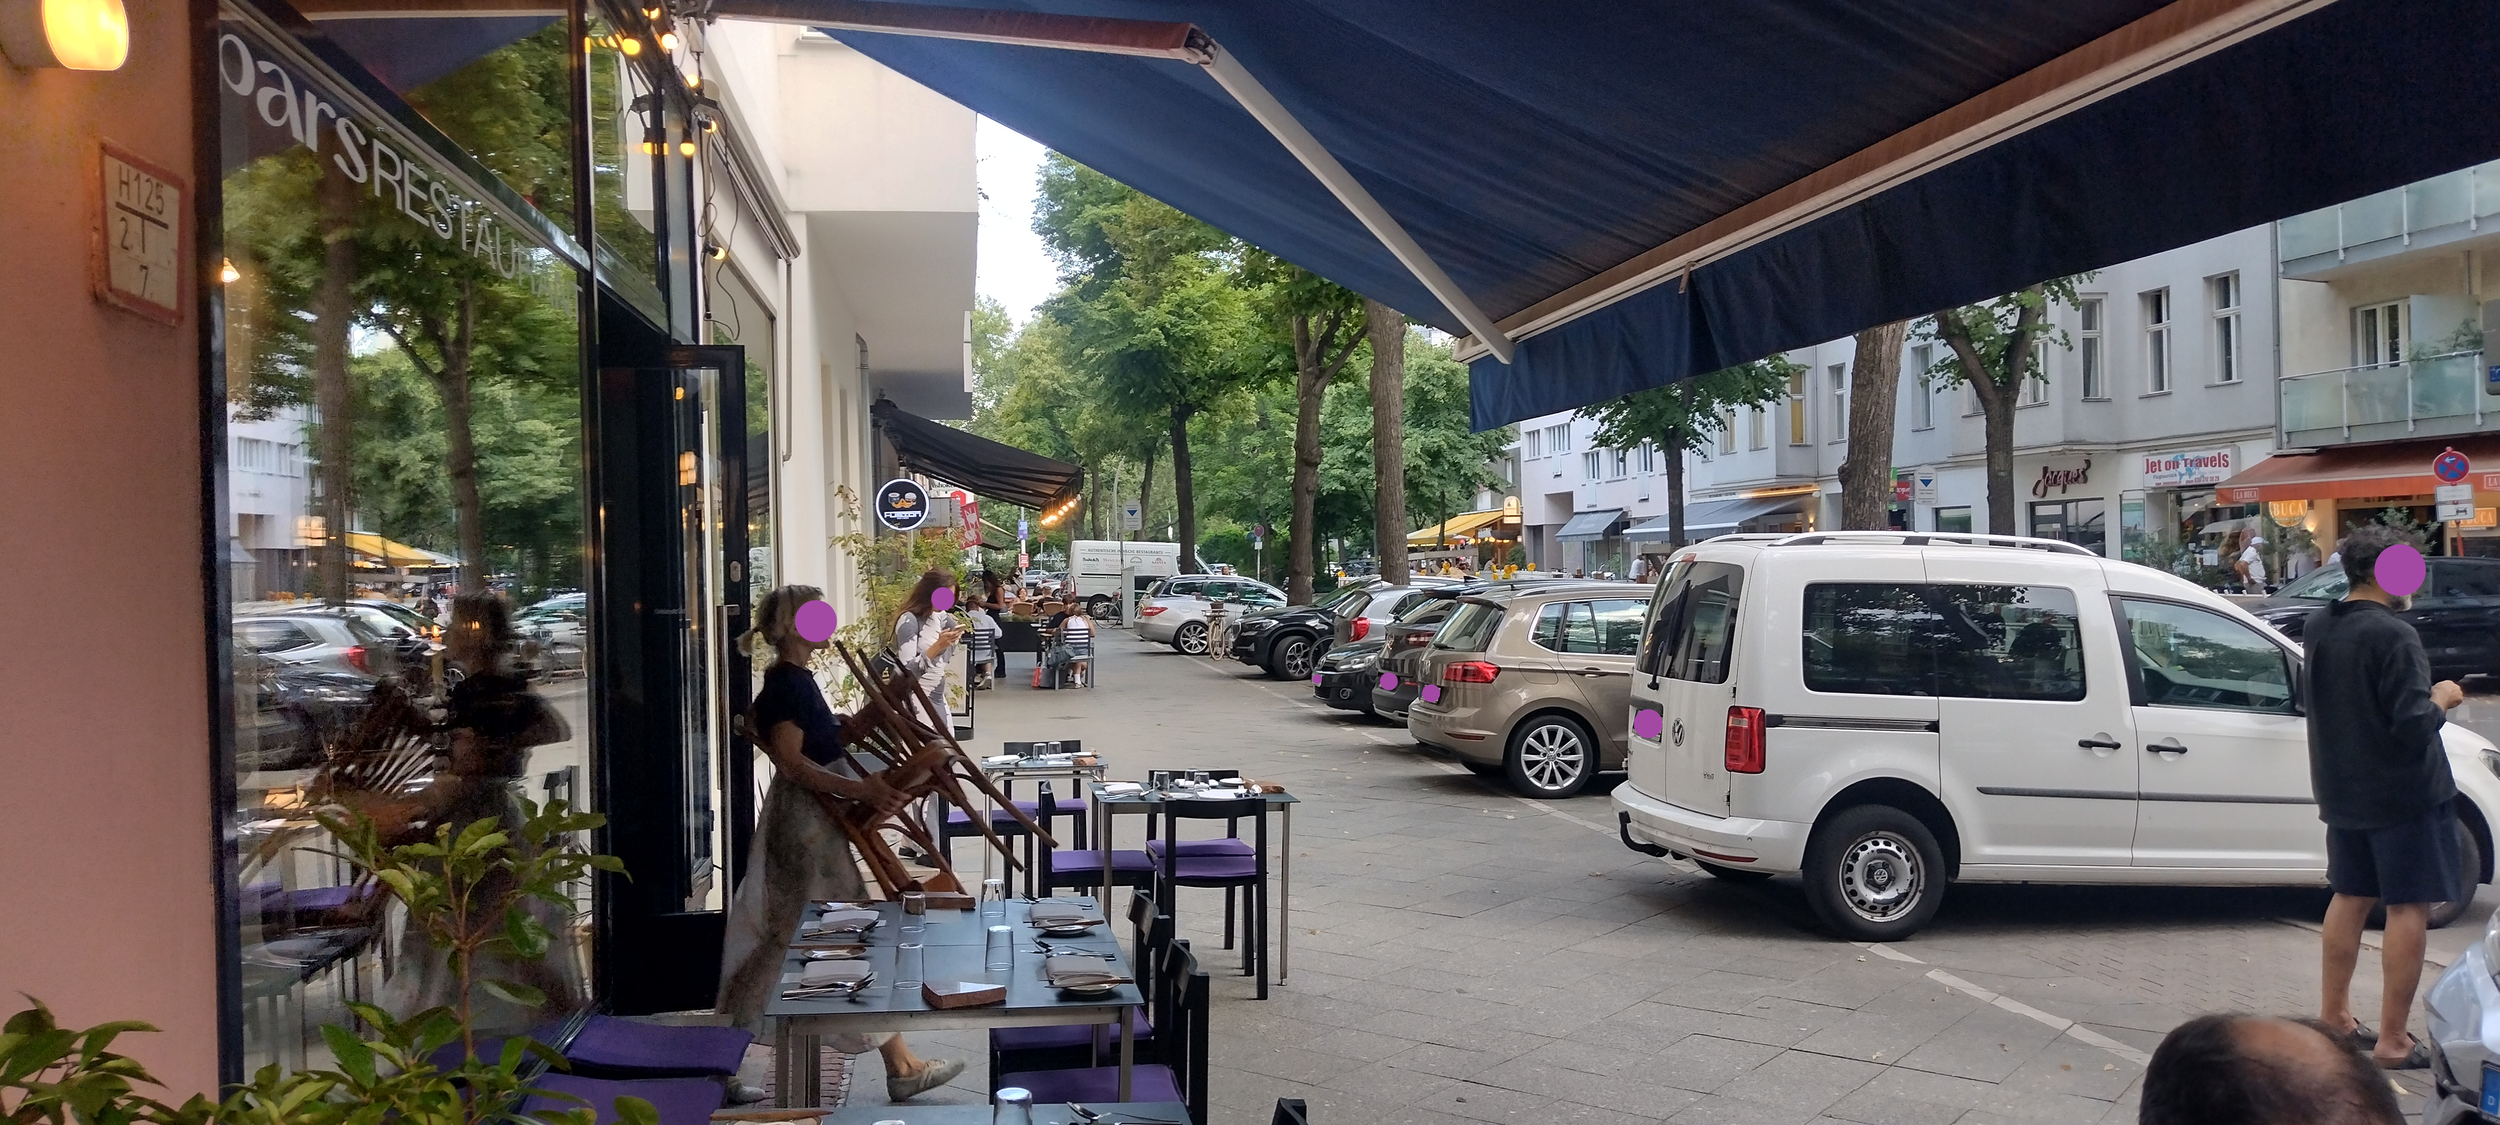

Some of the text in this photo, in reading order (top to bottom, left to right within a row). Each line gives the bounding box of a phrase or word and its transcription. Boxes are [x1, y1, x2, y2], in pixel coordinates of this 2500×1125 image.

[118, 164, 165, 216] H125
[2145, 458, 2162, 474] Jet
[2164, 460, 2180, 471] on
[2182, 452, 2230, 469] Travels
[2236, 491, 2257, 500] LA BUCA
[2273, 502, 2304, 516] BUCA
